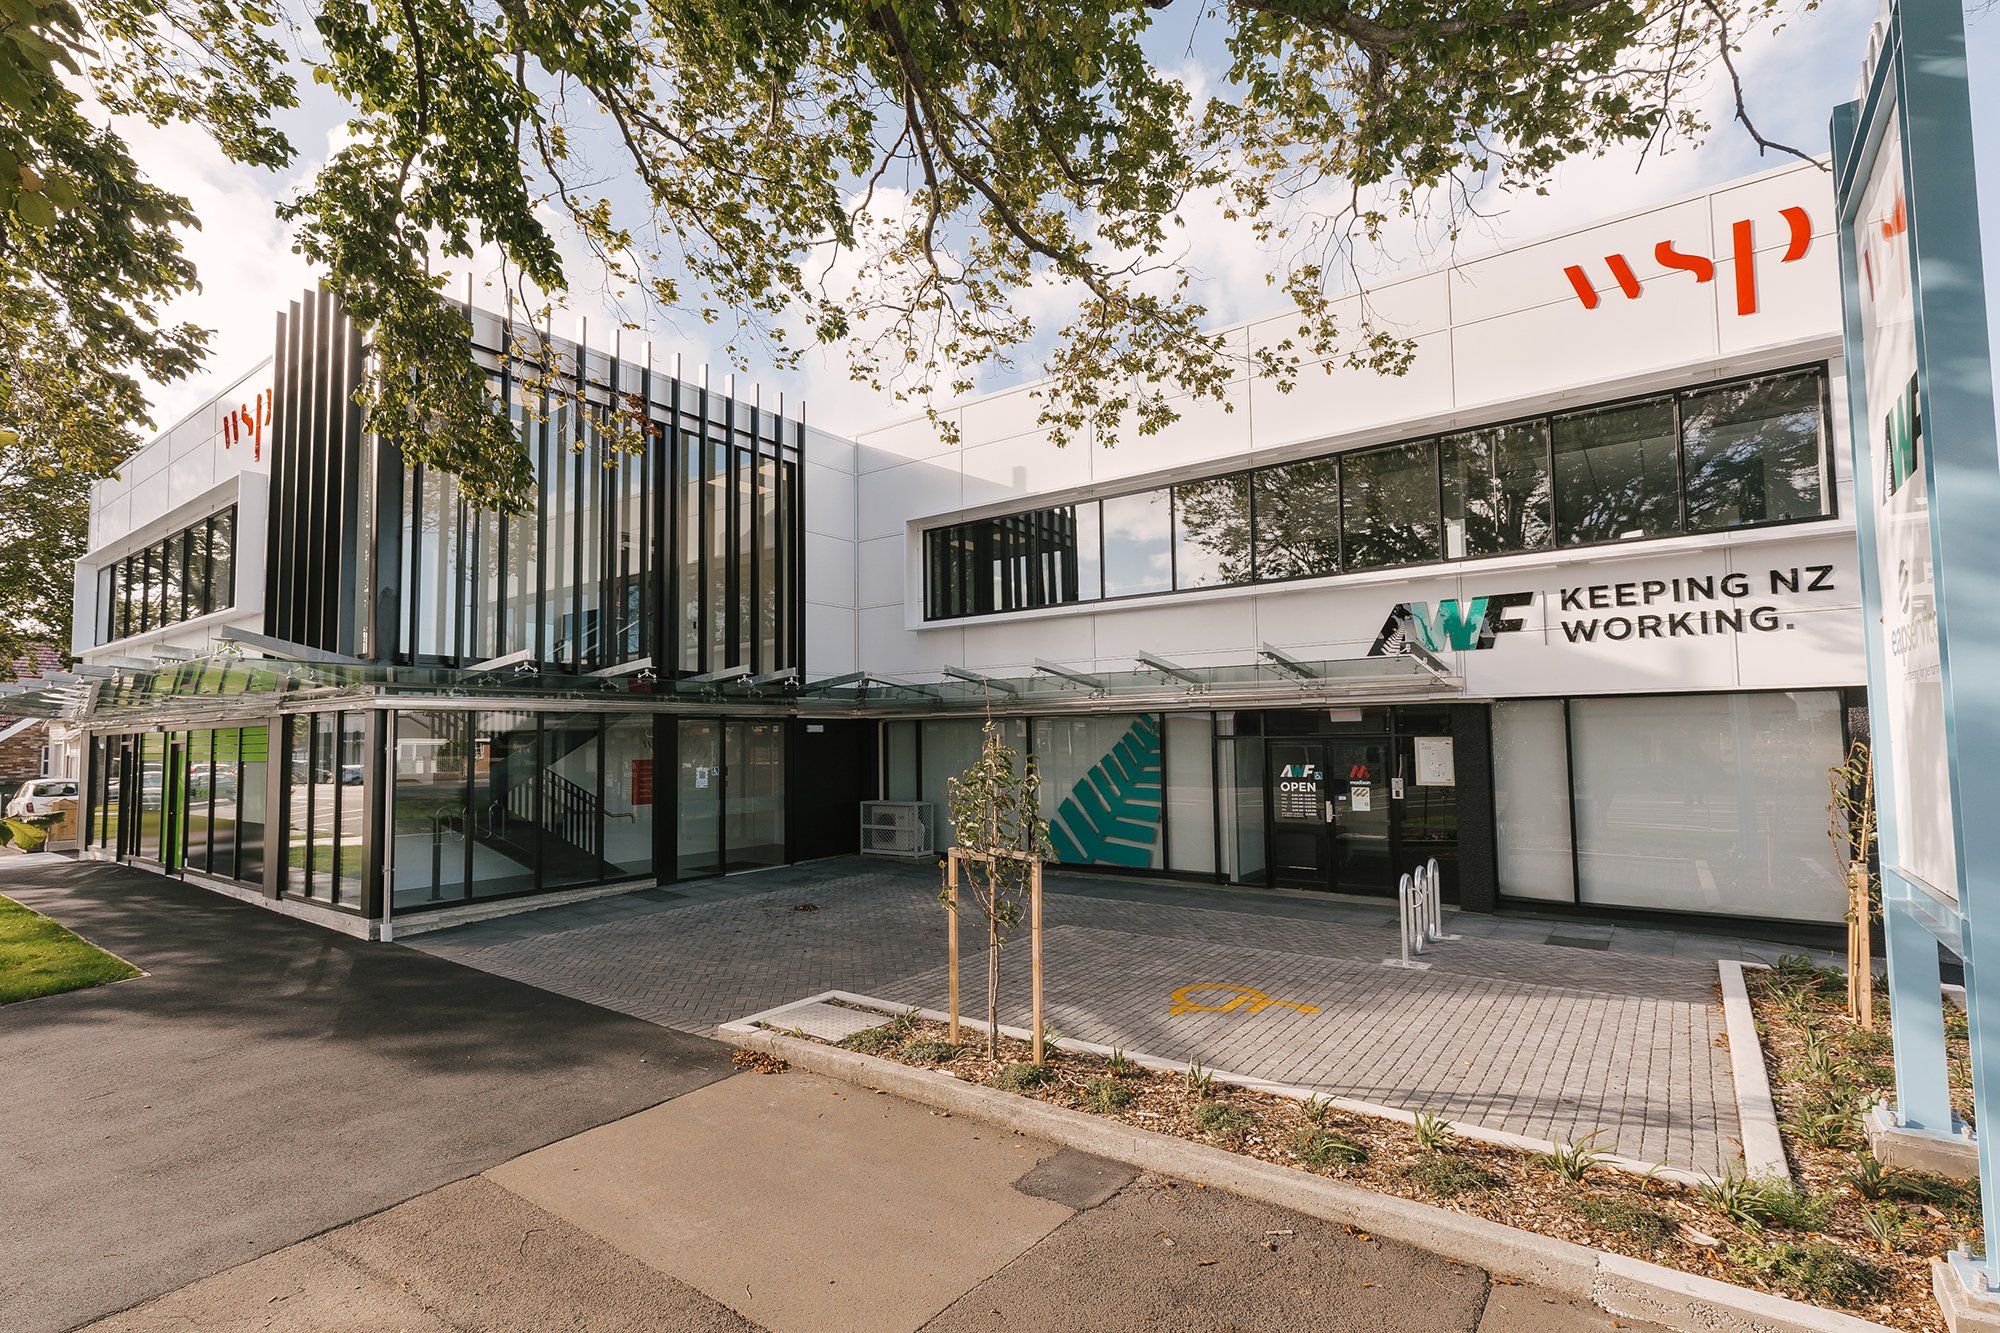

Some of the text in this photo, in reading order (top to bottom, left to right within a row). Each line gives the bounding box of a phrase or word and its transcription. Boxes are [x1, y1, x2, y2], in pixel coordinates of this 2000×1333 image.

[1563, 206, 1812, 316] wsp
[1560, 564, 1834, 611] KEEPING NZ
[1368, 591, 1534, 657] AWF
[1560, 605, 1795, 643] WORKING.
[1280, 764, 1315, 778] AWF
[1280, 781, 1316, 792] OPEN
